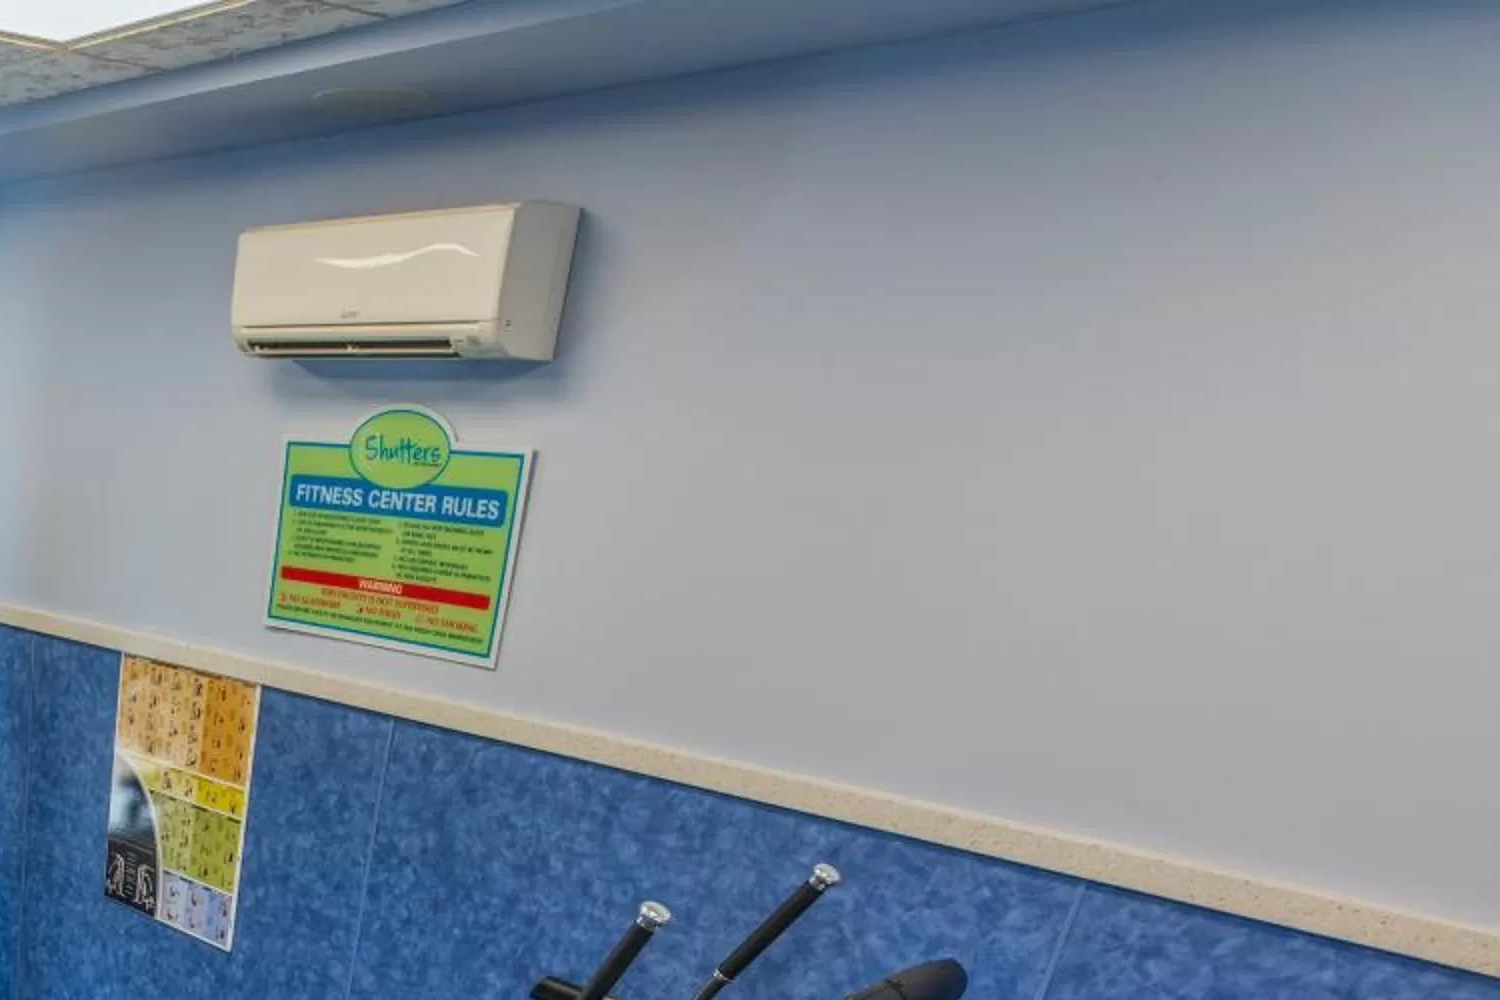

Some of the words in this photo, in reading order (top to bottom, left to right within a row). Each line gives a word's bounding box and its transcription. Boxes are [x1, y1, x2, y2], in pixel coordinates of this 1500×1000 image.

[364, 432, 442, 465] Shutters
[296, 483, 364, 507] FITNESS
[368, 490, 437, 514] CENTER
[441, 496, 501, 520] RULES
